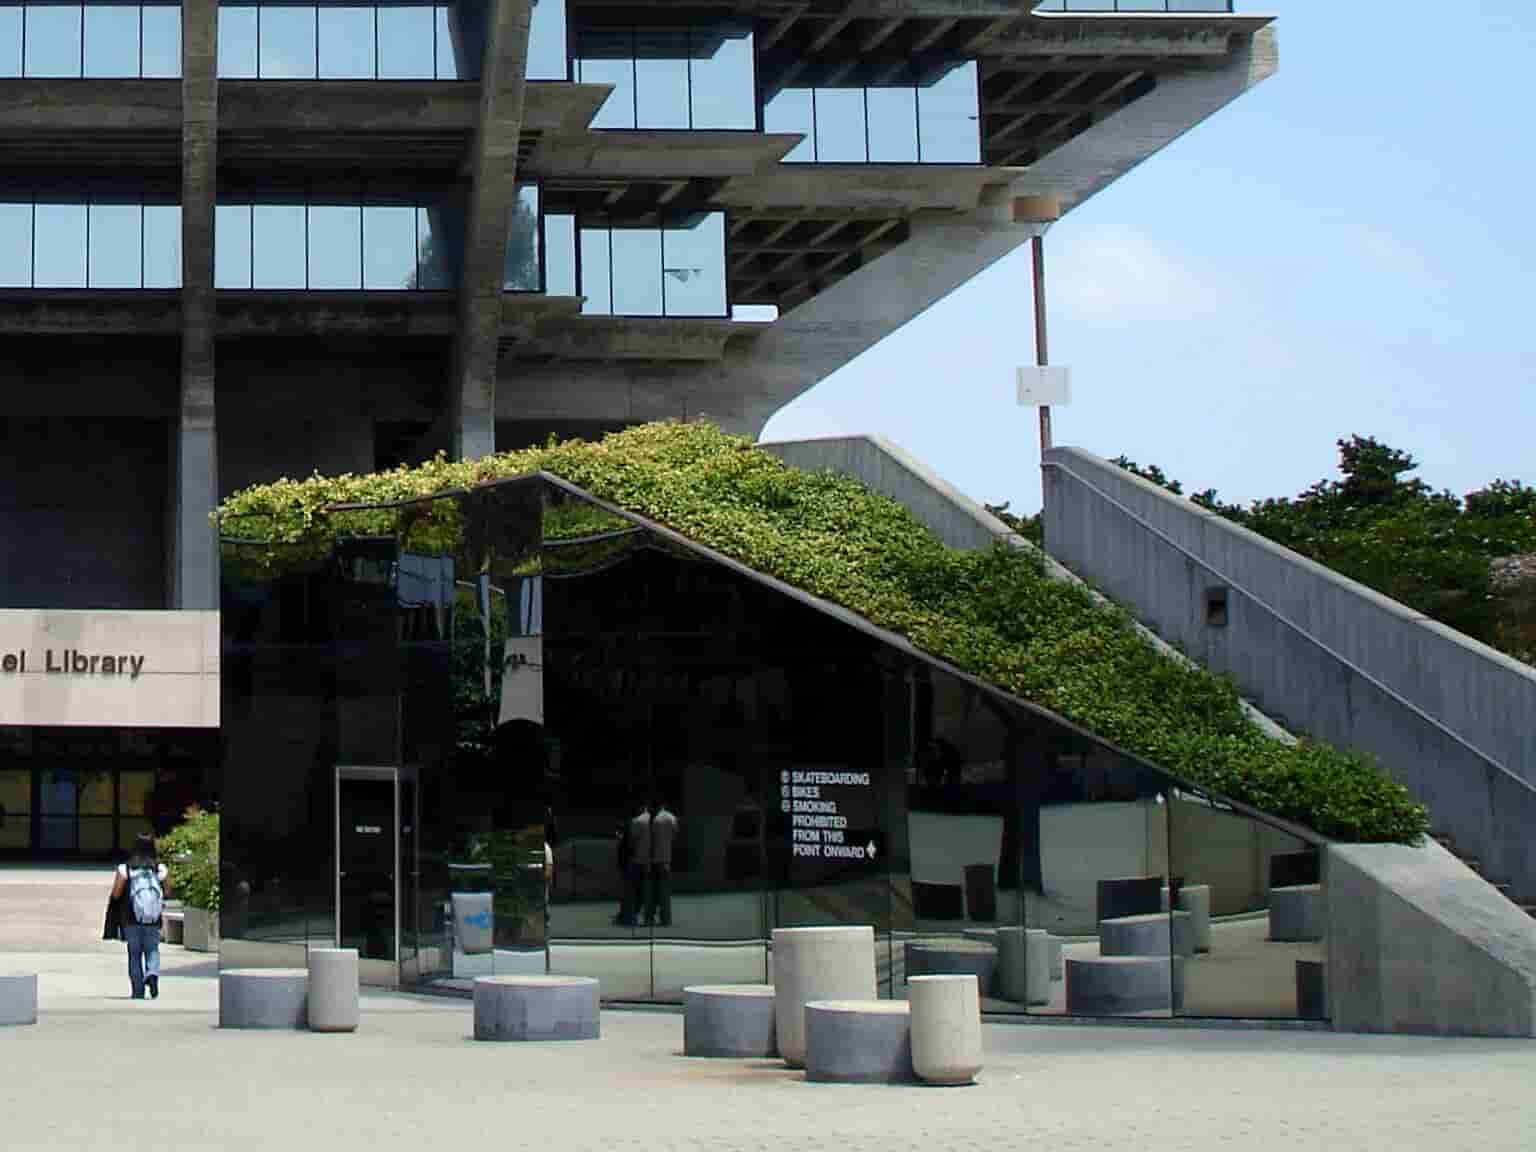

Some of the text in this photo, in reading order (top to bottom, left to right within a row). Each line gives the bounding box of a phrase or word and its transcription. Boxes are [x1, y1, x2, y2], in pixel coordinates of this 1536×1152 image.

[45, 648, 145, 681] Library
[791, 771, 870, 785] SKATEBOARDING
[791, 785, 820, 798] BIKES
[792, 799, 837, 813] SMOKING
[792, 814, 847, 828] PROHIBITED
[792, 829, 844, 843] FROM THIS
[792, 844, 865, 858] POINT ONWARD
